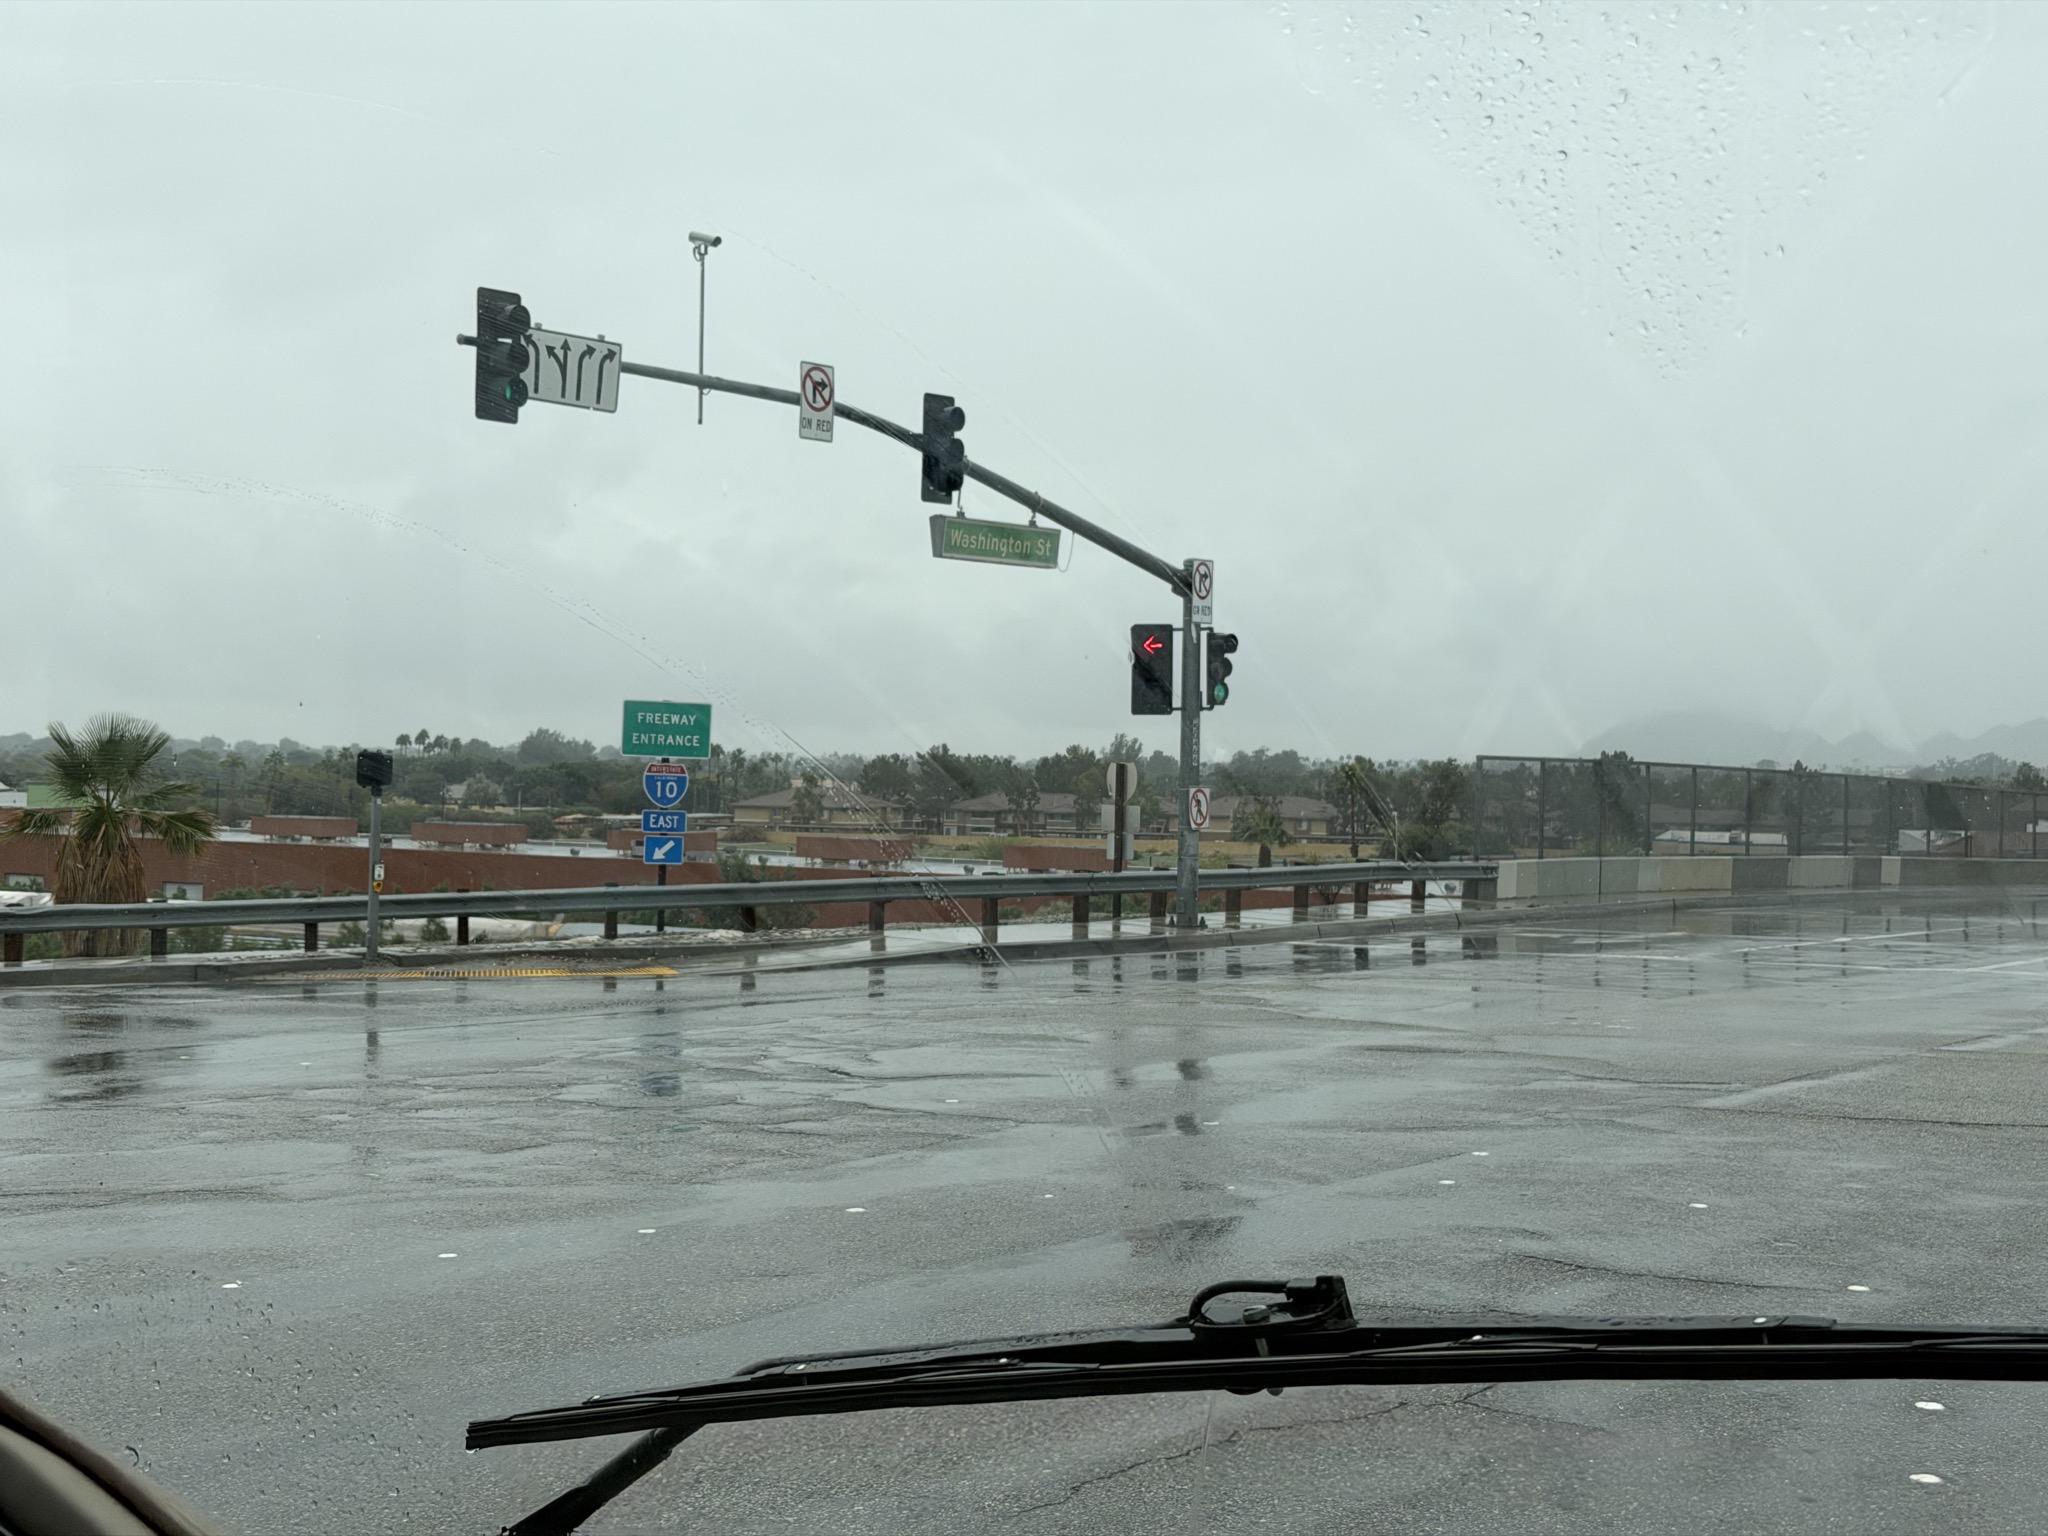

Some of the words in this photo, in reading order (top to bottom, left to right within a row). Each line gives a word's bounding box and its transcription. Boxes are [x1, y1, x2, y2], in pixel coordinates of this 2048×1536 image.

[802, 417, 812, 430] ON
[816, 419, 831, 432] RED
[951, 529, 1030, 557] Washington
[1036, 538, 1051, 556] St
[638, 712, 696, 726] FREEWAY
[632, 733, 700, 746] ENTRANCE
[656, 781, 677, 798] 10
[650, 814, 679, 829] EAST
